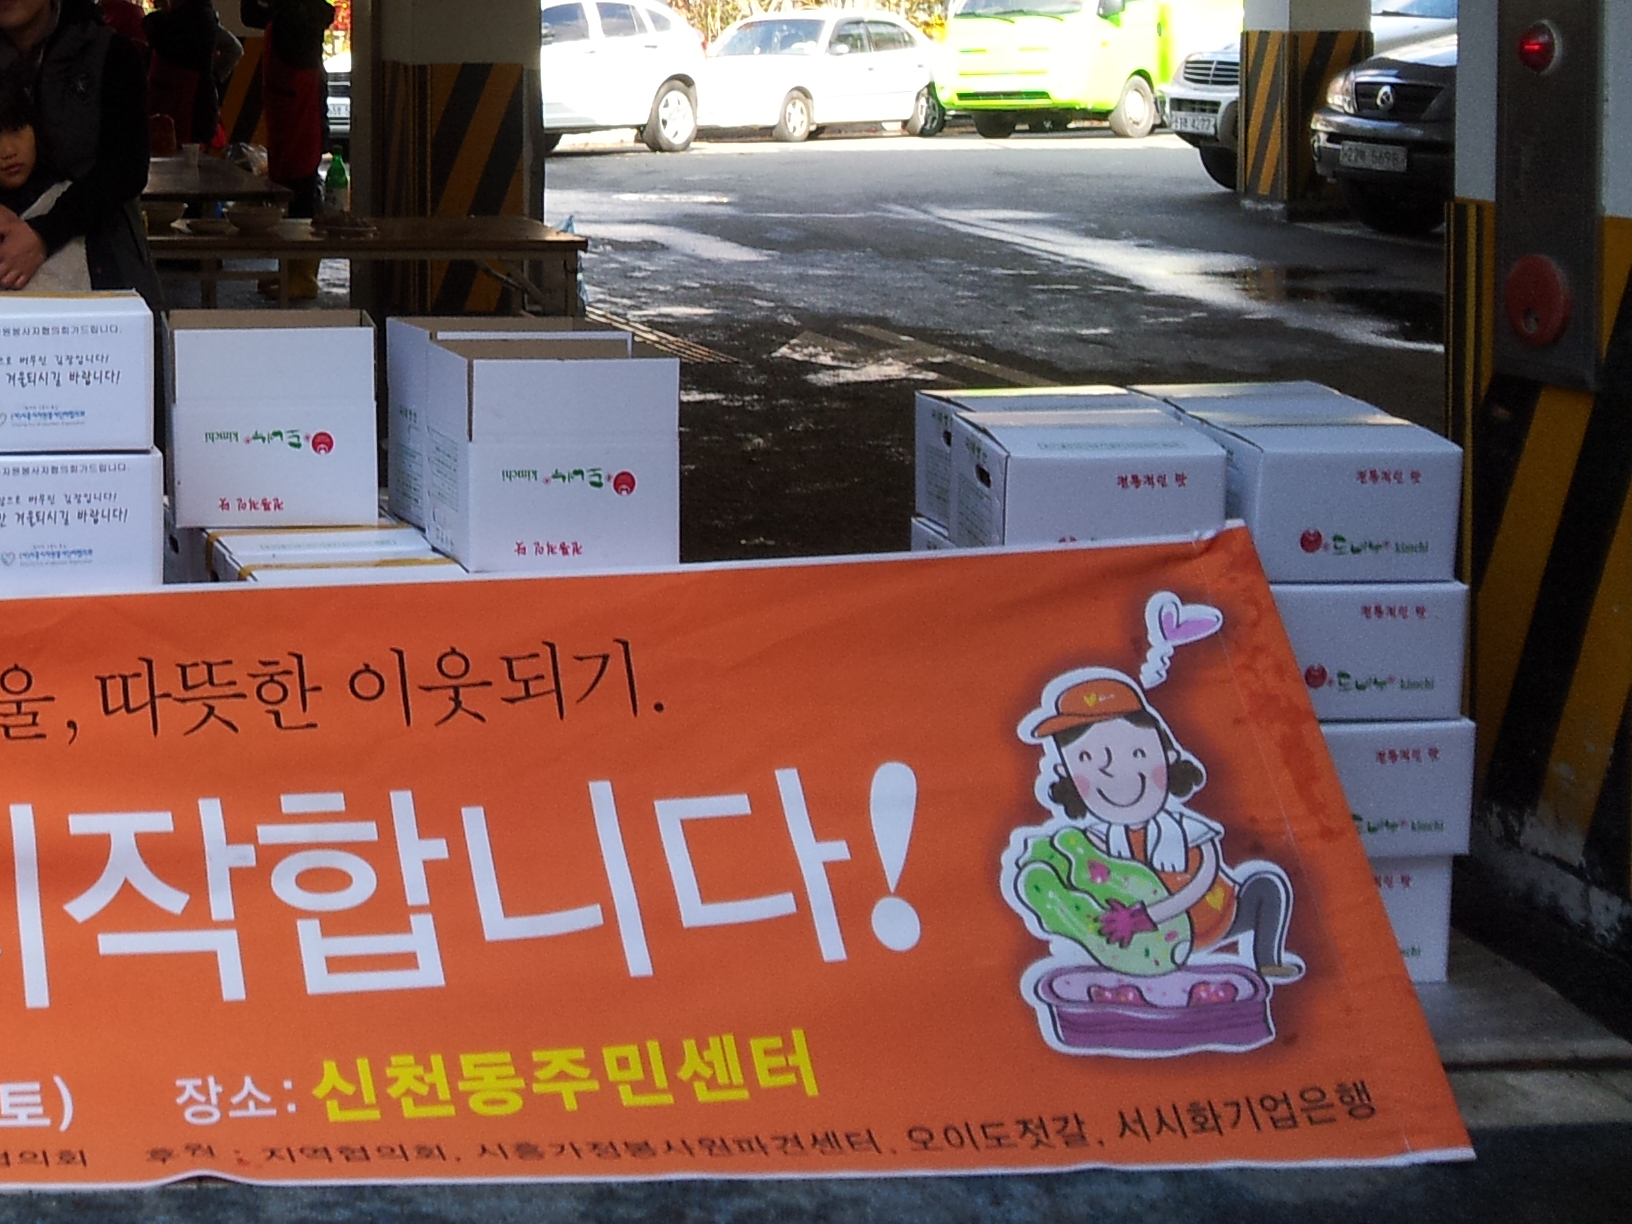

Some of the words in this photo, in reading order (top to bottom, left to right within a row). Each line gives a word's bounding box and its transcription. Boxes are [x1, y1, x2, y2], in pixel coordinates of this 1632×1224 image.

[95, 652, 323, 737] 따뜻한
[348, 638, 665, 727] 이웃되기.
[175, 1074, 298, 1125] 장소:
[311, 1027, 821, 1123] 신천동주민센터
